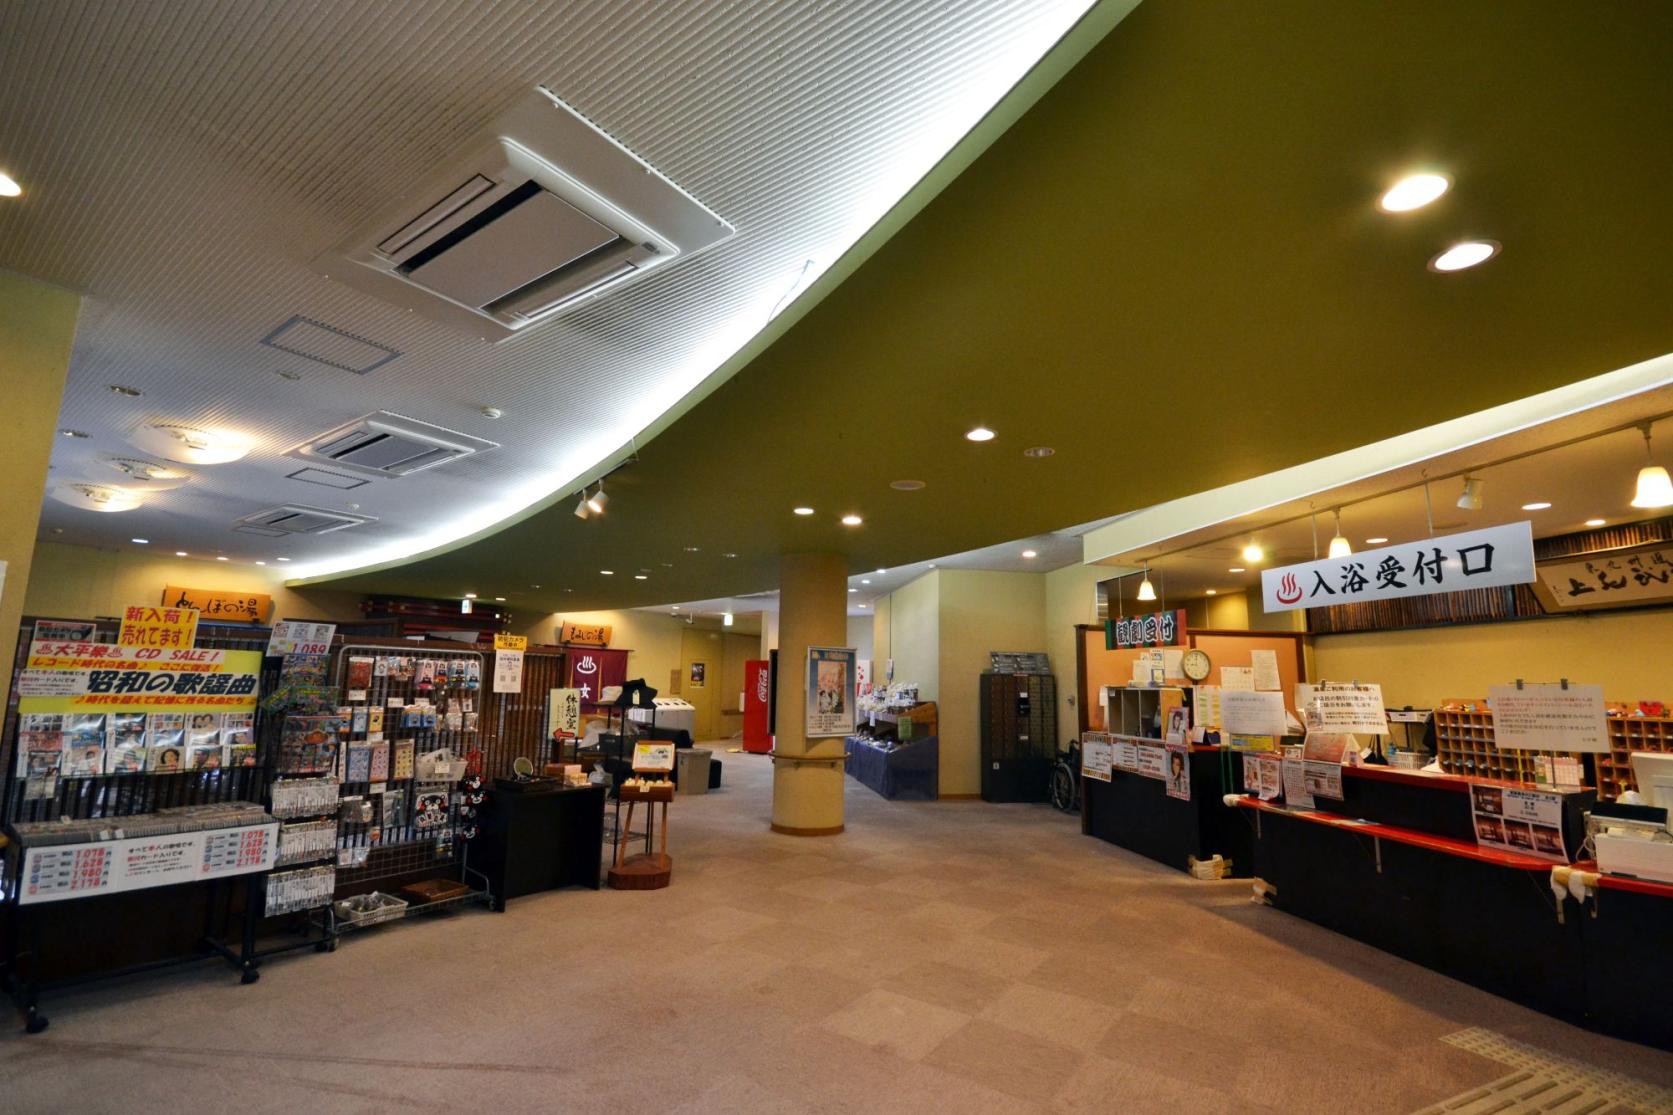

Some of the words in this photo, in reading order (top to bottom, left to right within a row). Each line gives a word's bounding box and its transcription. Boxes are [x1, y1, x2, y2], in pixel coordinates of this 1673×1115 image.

[1310, 543, 1495, 597] 入浴受付口
[125, 606, 193, 623] 新入荷！
[121, 625, 192, 646] 売れてます！
[1116, 615, 1175, 646] 観劇受付
[135, 648, 161, 660] CD
[86, 670, 257, 695] 昭和の歌謡曲
[580, 683, 591, 699] 女
